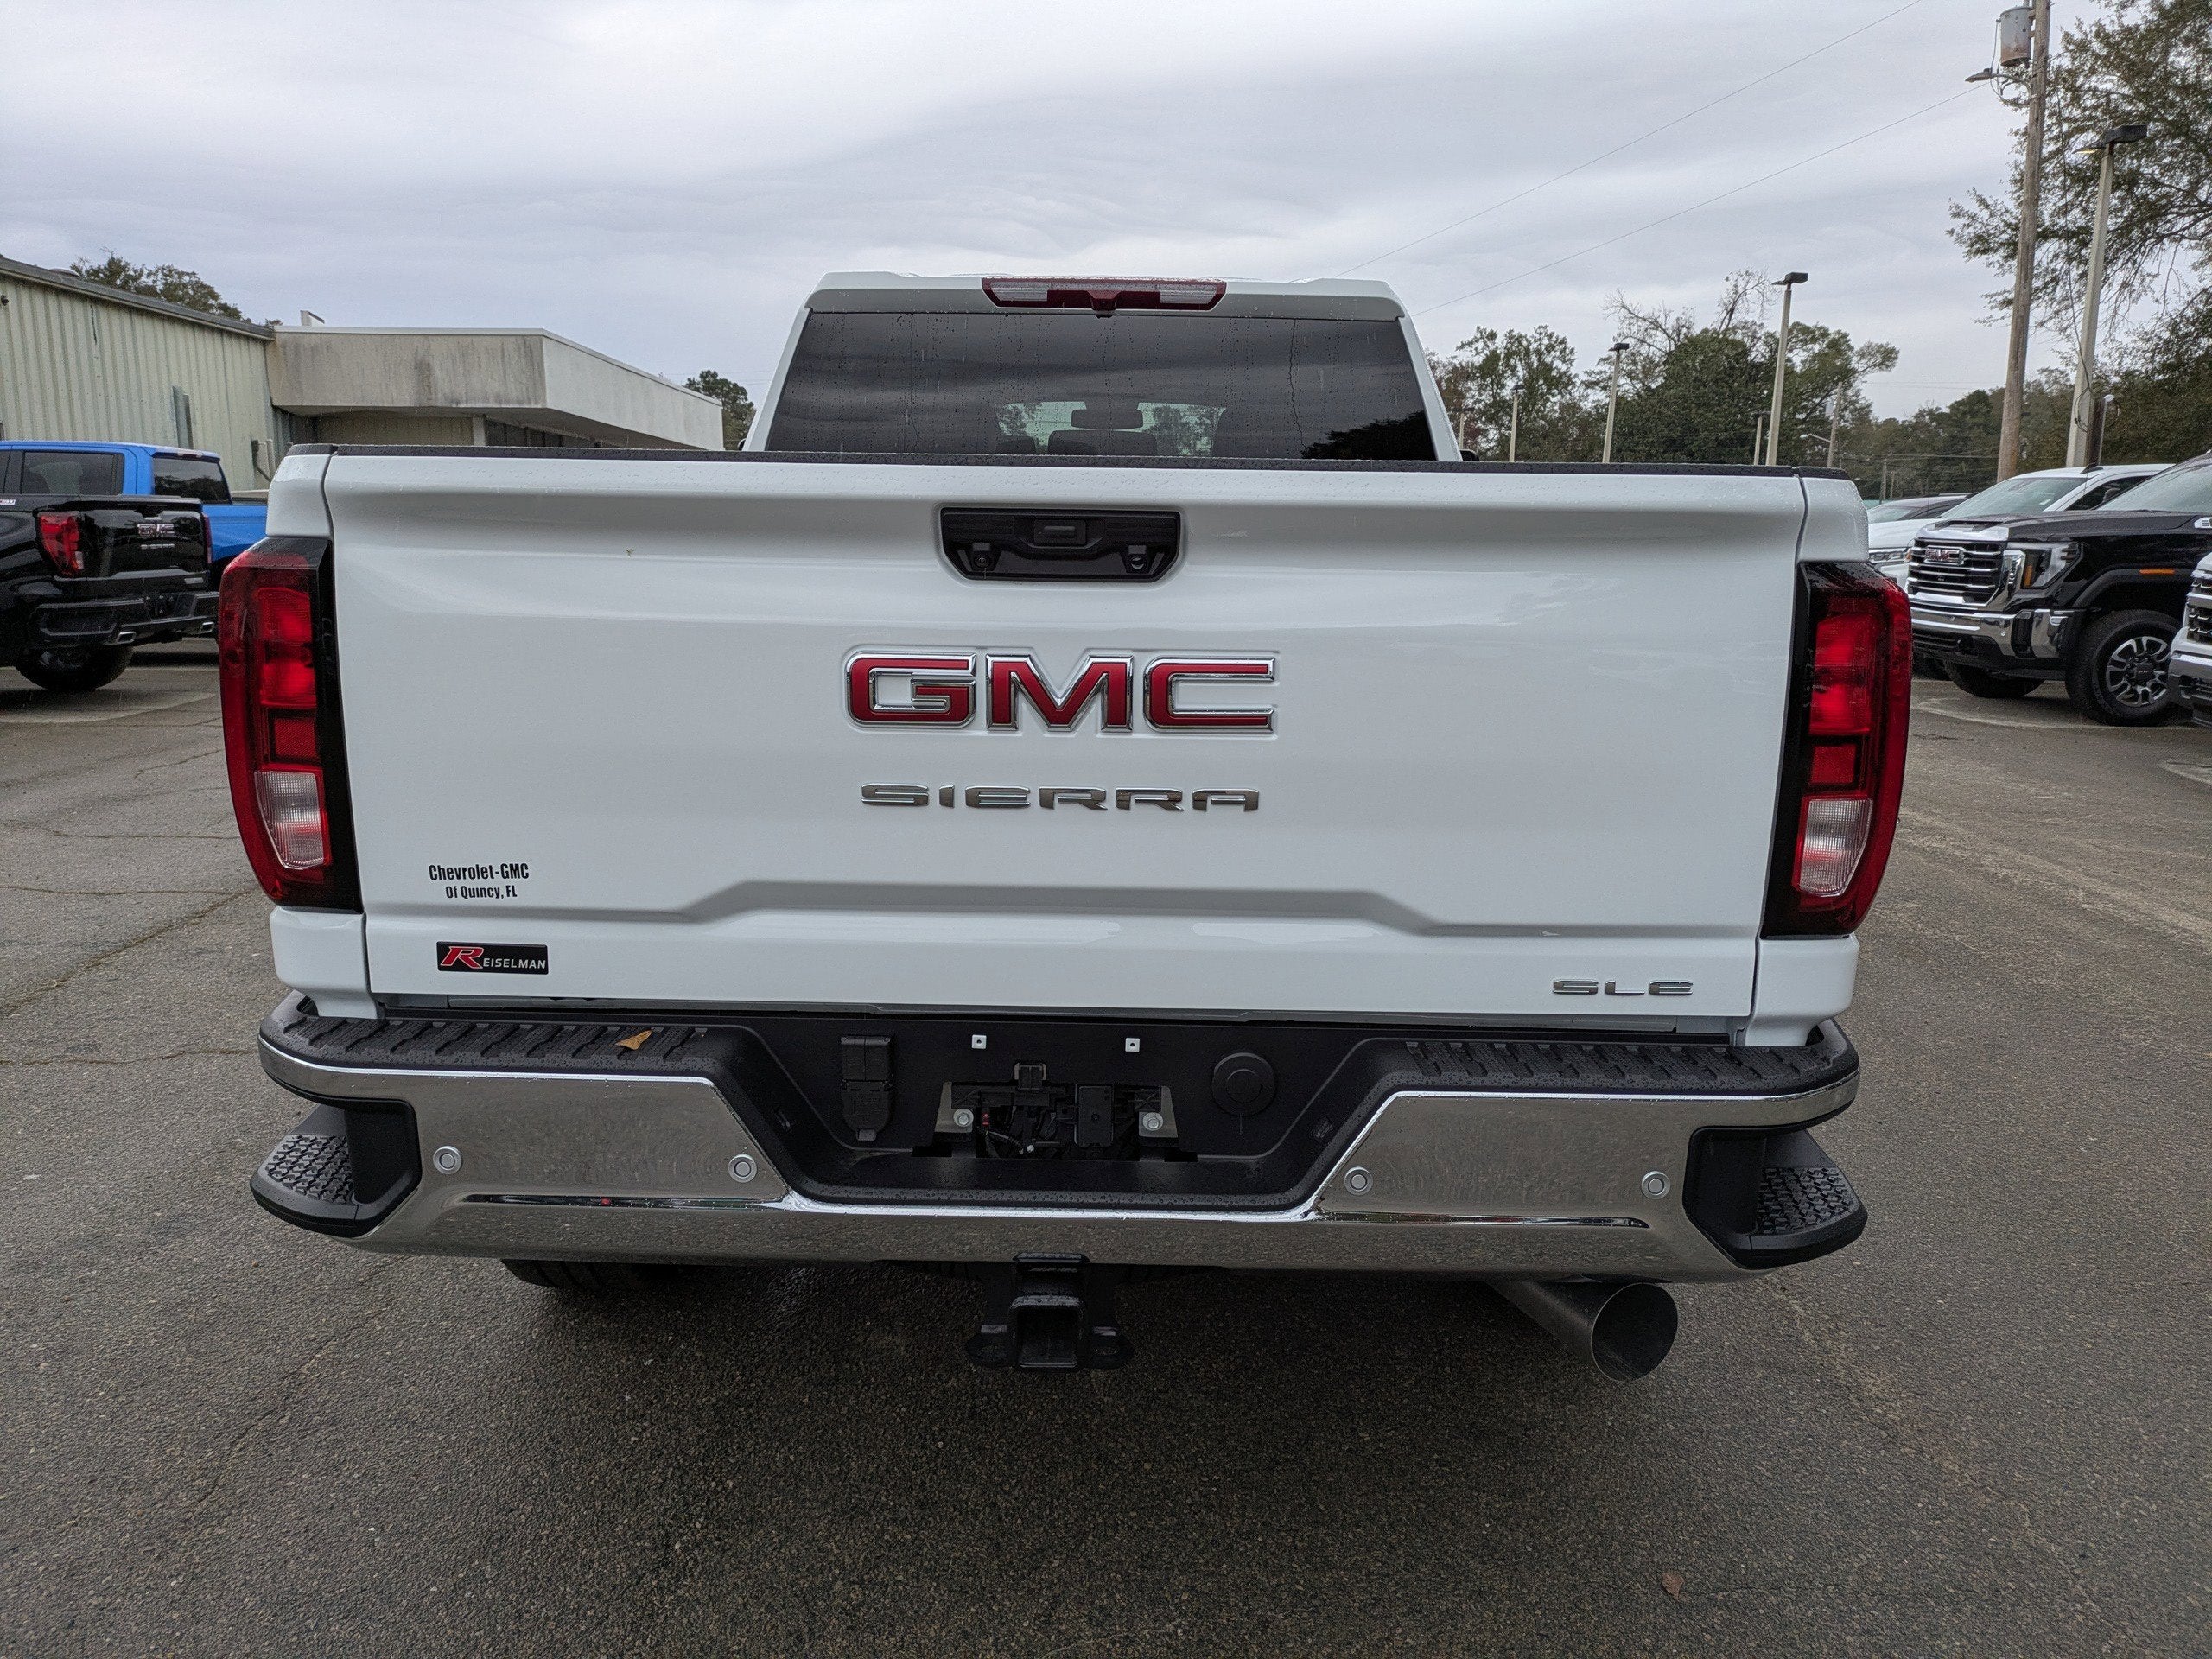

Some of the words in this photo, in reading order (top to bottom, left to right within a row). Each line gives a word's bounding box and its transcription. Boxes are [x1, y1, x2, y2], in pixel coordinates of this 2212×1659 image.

[846, 652, 1276, 733] GMC
[861, 784, 1260, 812] SIERRA
[429, 863, 530, 880] Chevrolet-GMC
[446, 886, 458, 899] Of
[460, 885, 505, 899] Quincy,
[505, 885, 518, 898] FL
[440, 945, 546, 969] REISELMAN
[1553, 979, 1694, 995] SLE
